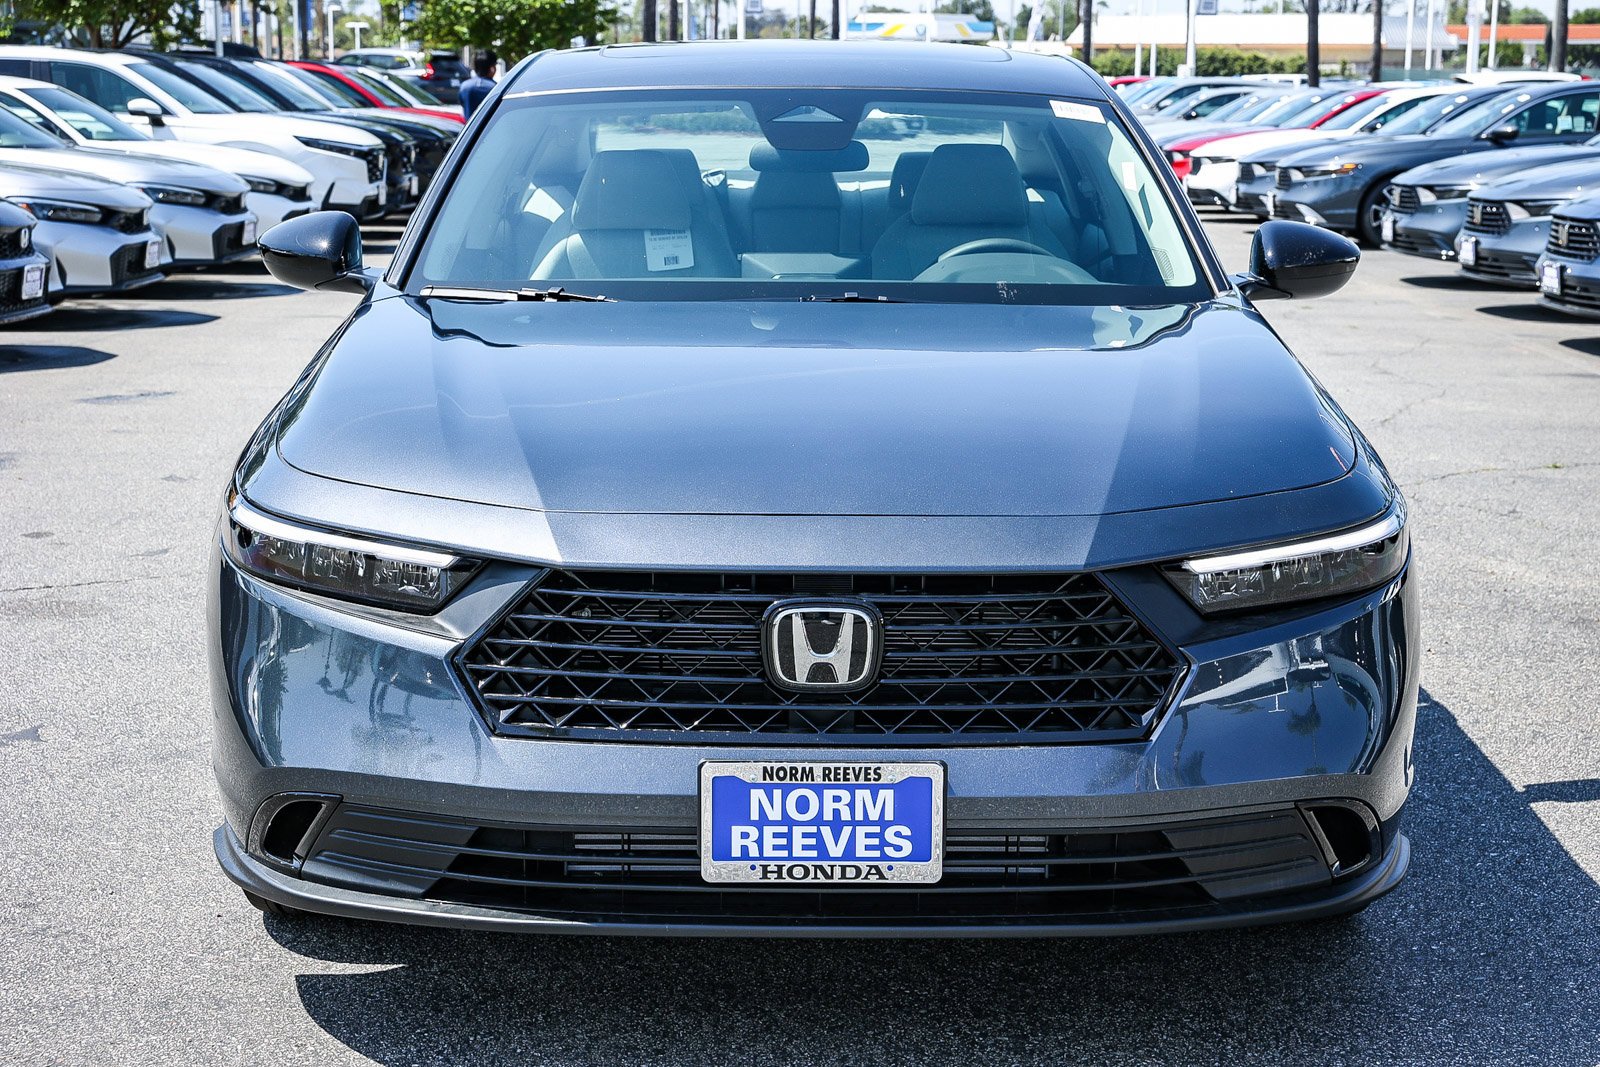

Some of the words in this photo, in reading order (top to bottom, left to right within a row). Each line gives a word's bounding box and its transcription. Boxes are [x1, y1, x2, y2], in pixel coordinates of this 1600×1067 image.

[762, 766, 815, 782] NORM
[822, 767, 882, 782] REEVES
[750, 788, 894, 821] NORM
[731, 825, 913, 858] REEVES
[759, 864, 889, 881] HONDA
